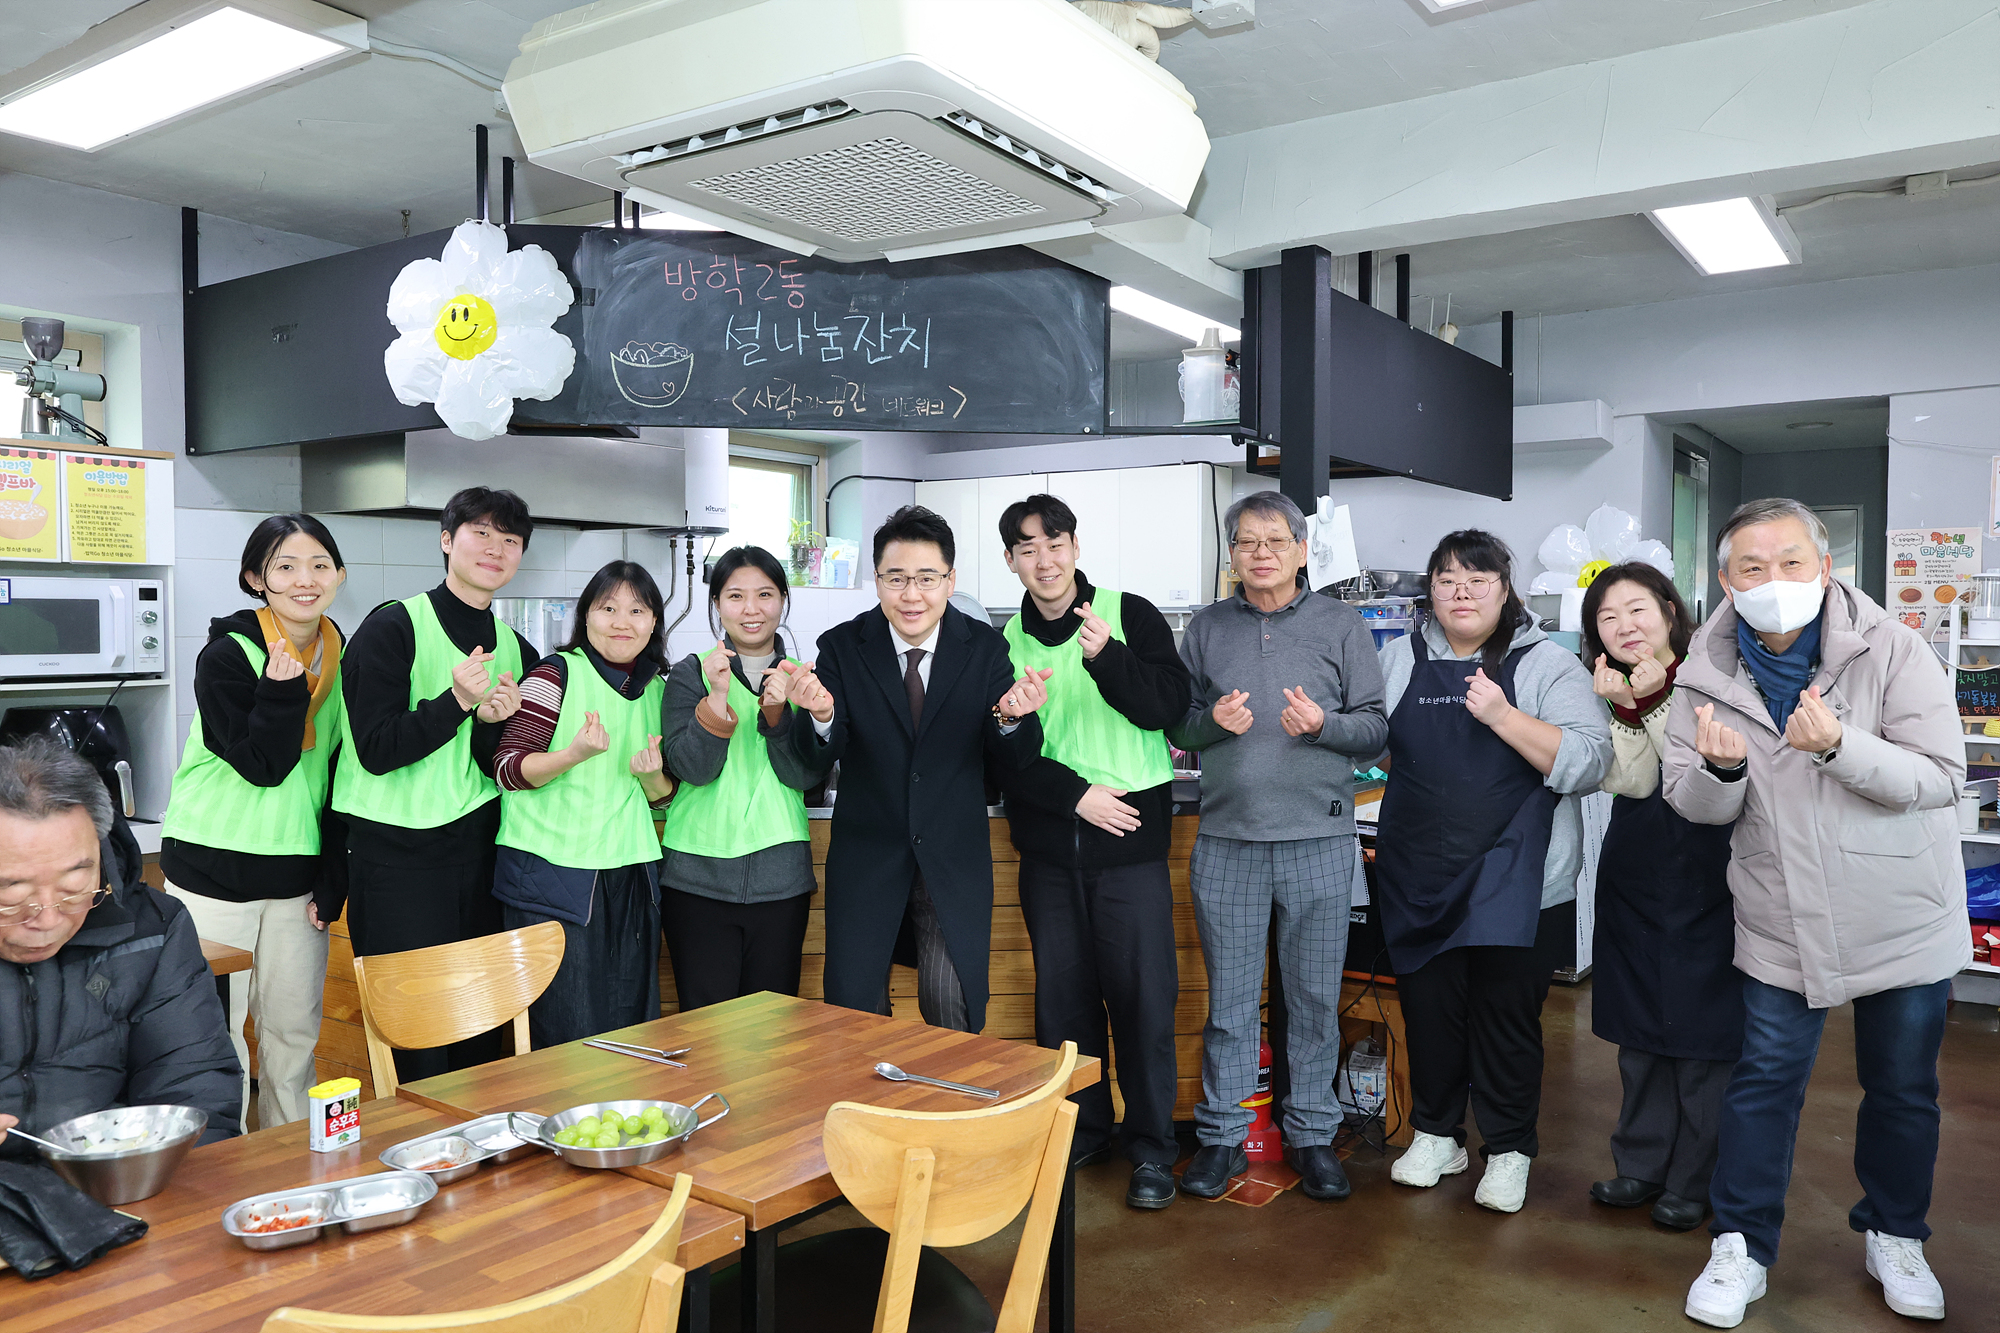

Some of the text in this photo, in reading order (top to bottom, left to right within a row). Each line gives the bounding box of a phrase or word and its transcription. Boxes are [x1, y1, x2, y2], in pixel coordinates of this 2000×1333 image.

[664, 253, 806, 309] 방학2동
[84, 471, 128, 486] 이용방법
[1920, 544, 1974, 558] 마을식당
[329, 1111, 358, 1132] 순후추
